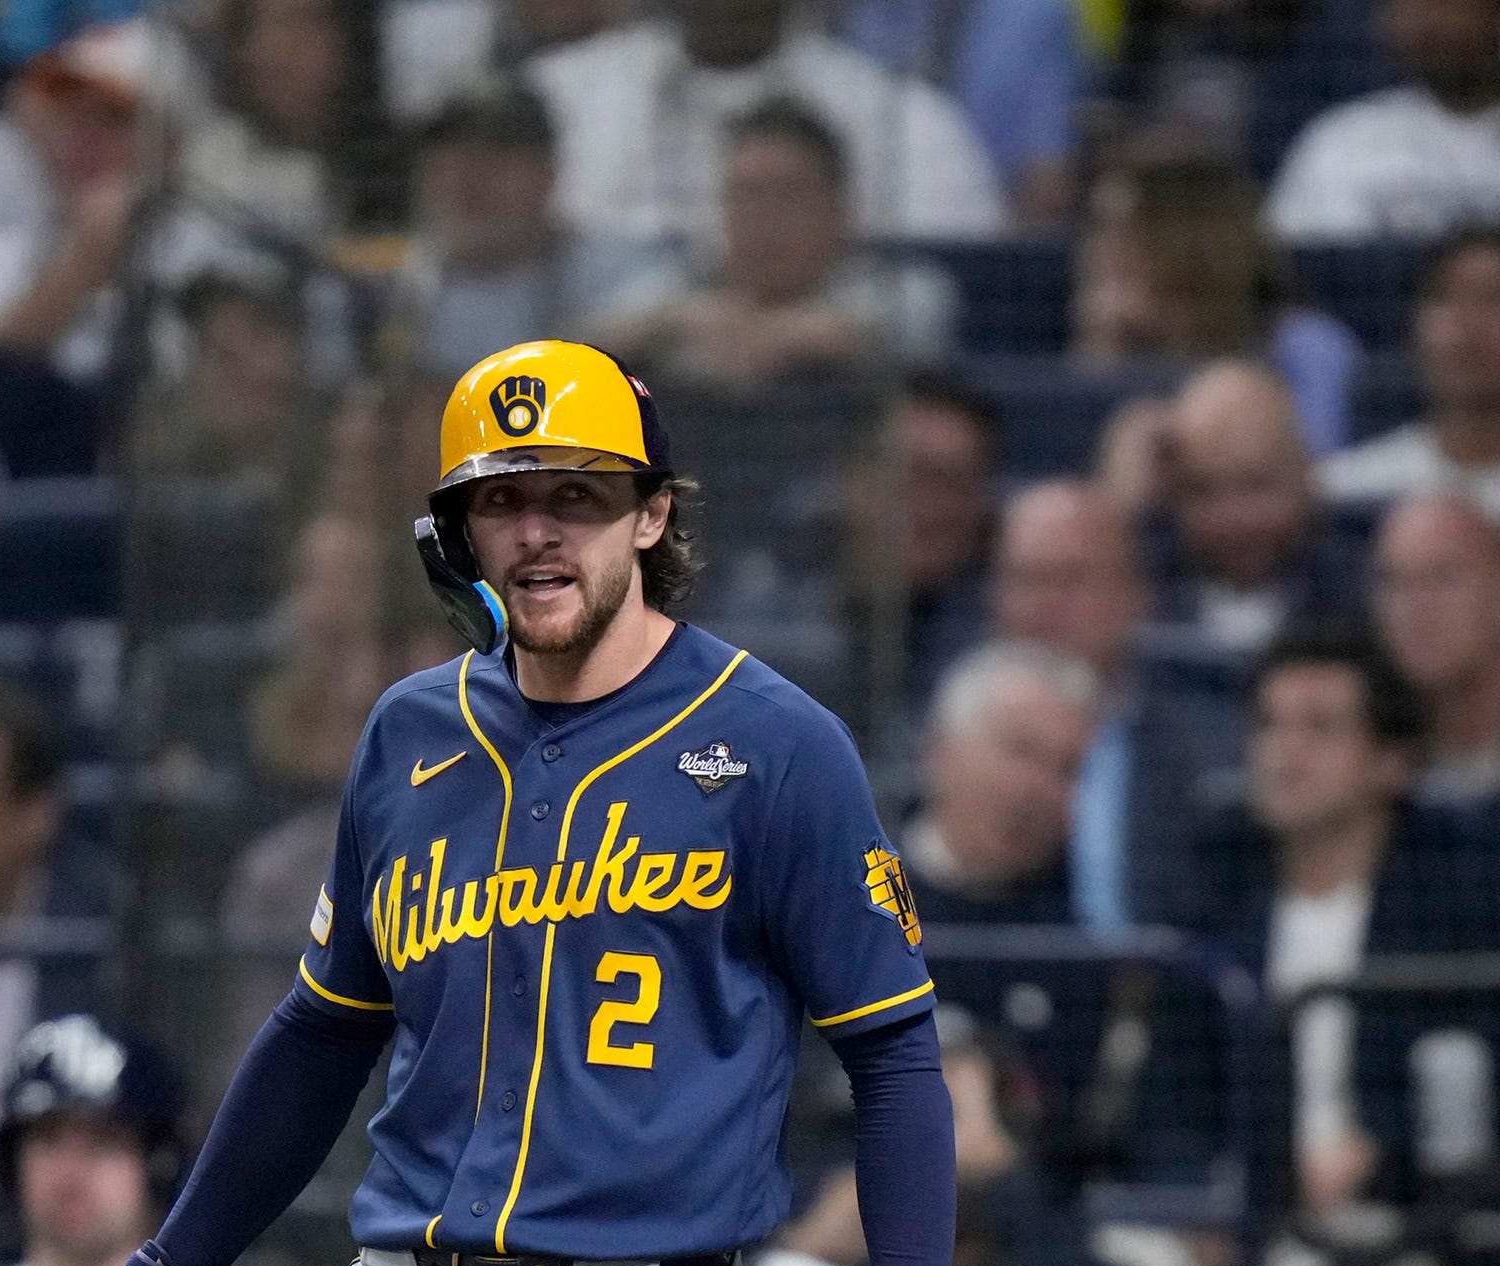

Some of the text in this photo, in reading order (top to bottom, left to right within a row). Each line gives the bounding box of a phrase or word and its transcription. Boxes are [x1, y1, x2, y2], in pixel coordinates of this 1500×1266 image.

[678, 752, 748, 780] World Series
[372, 801, 733, 972] Milwaukee
[586, 951, 662, 1069] 2
